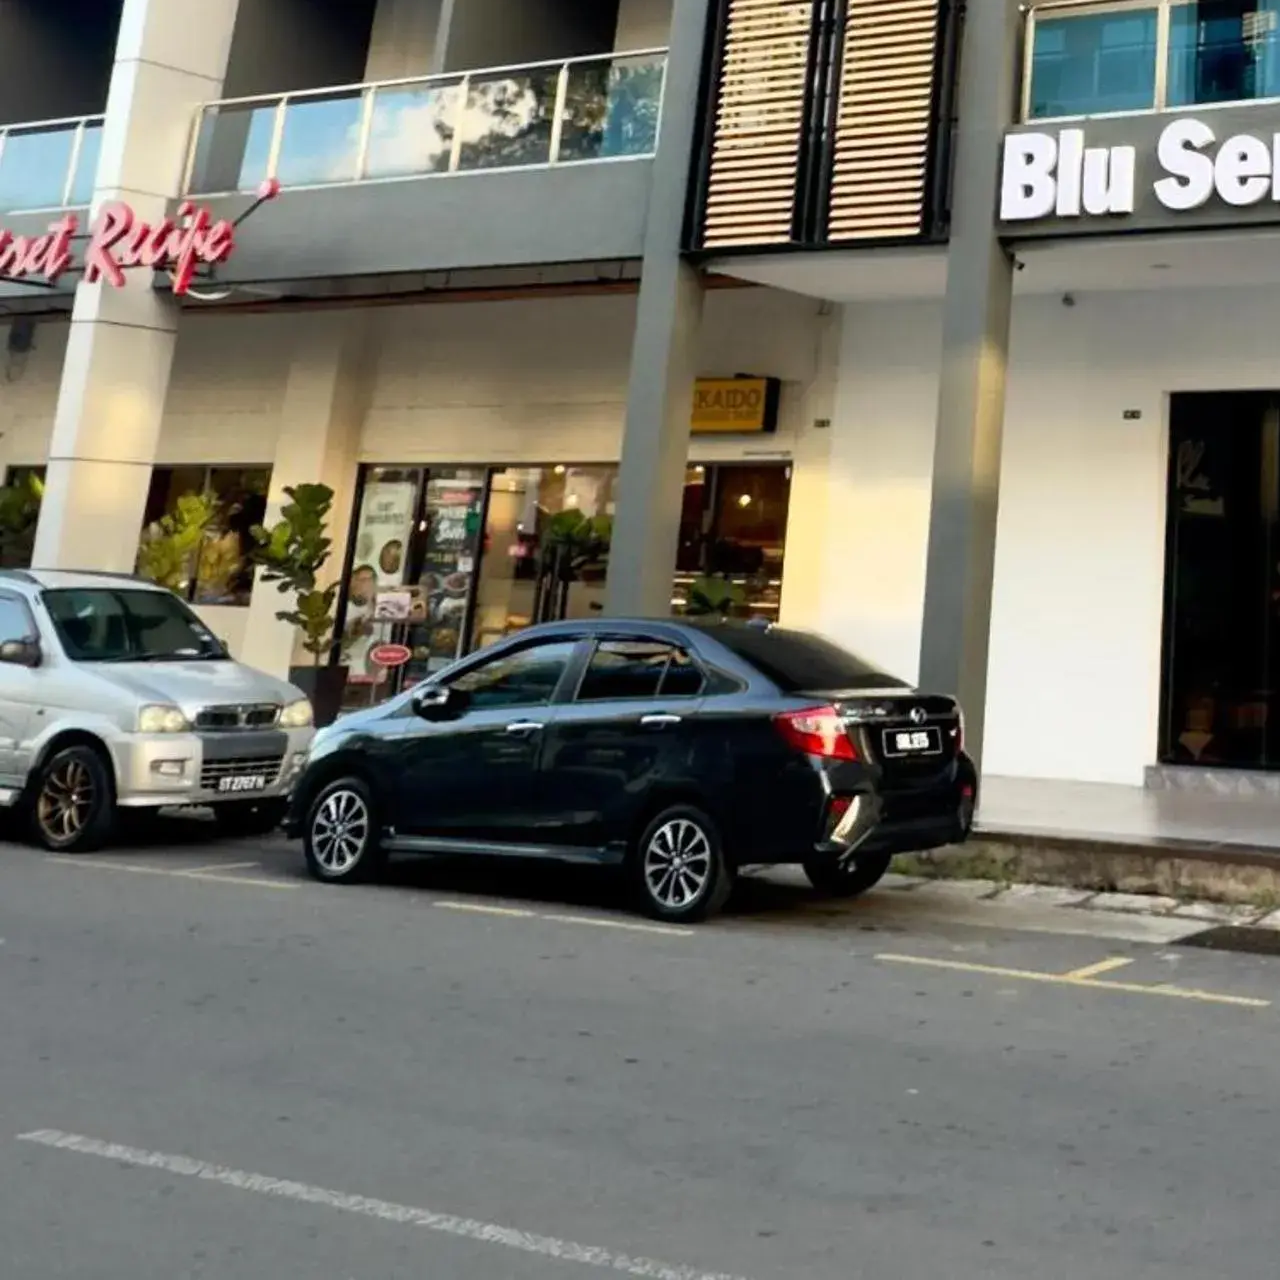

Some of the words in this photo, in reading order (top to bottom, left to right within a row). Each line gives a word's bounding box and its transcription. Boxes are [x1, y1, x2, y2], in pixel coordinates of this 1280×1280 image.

[1000, 129, 1135, 220] Blu
[84, 200, 236, 297] Recipe
[694, 387, 762, 411] KAIDO
